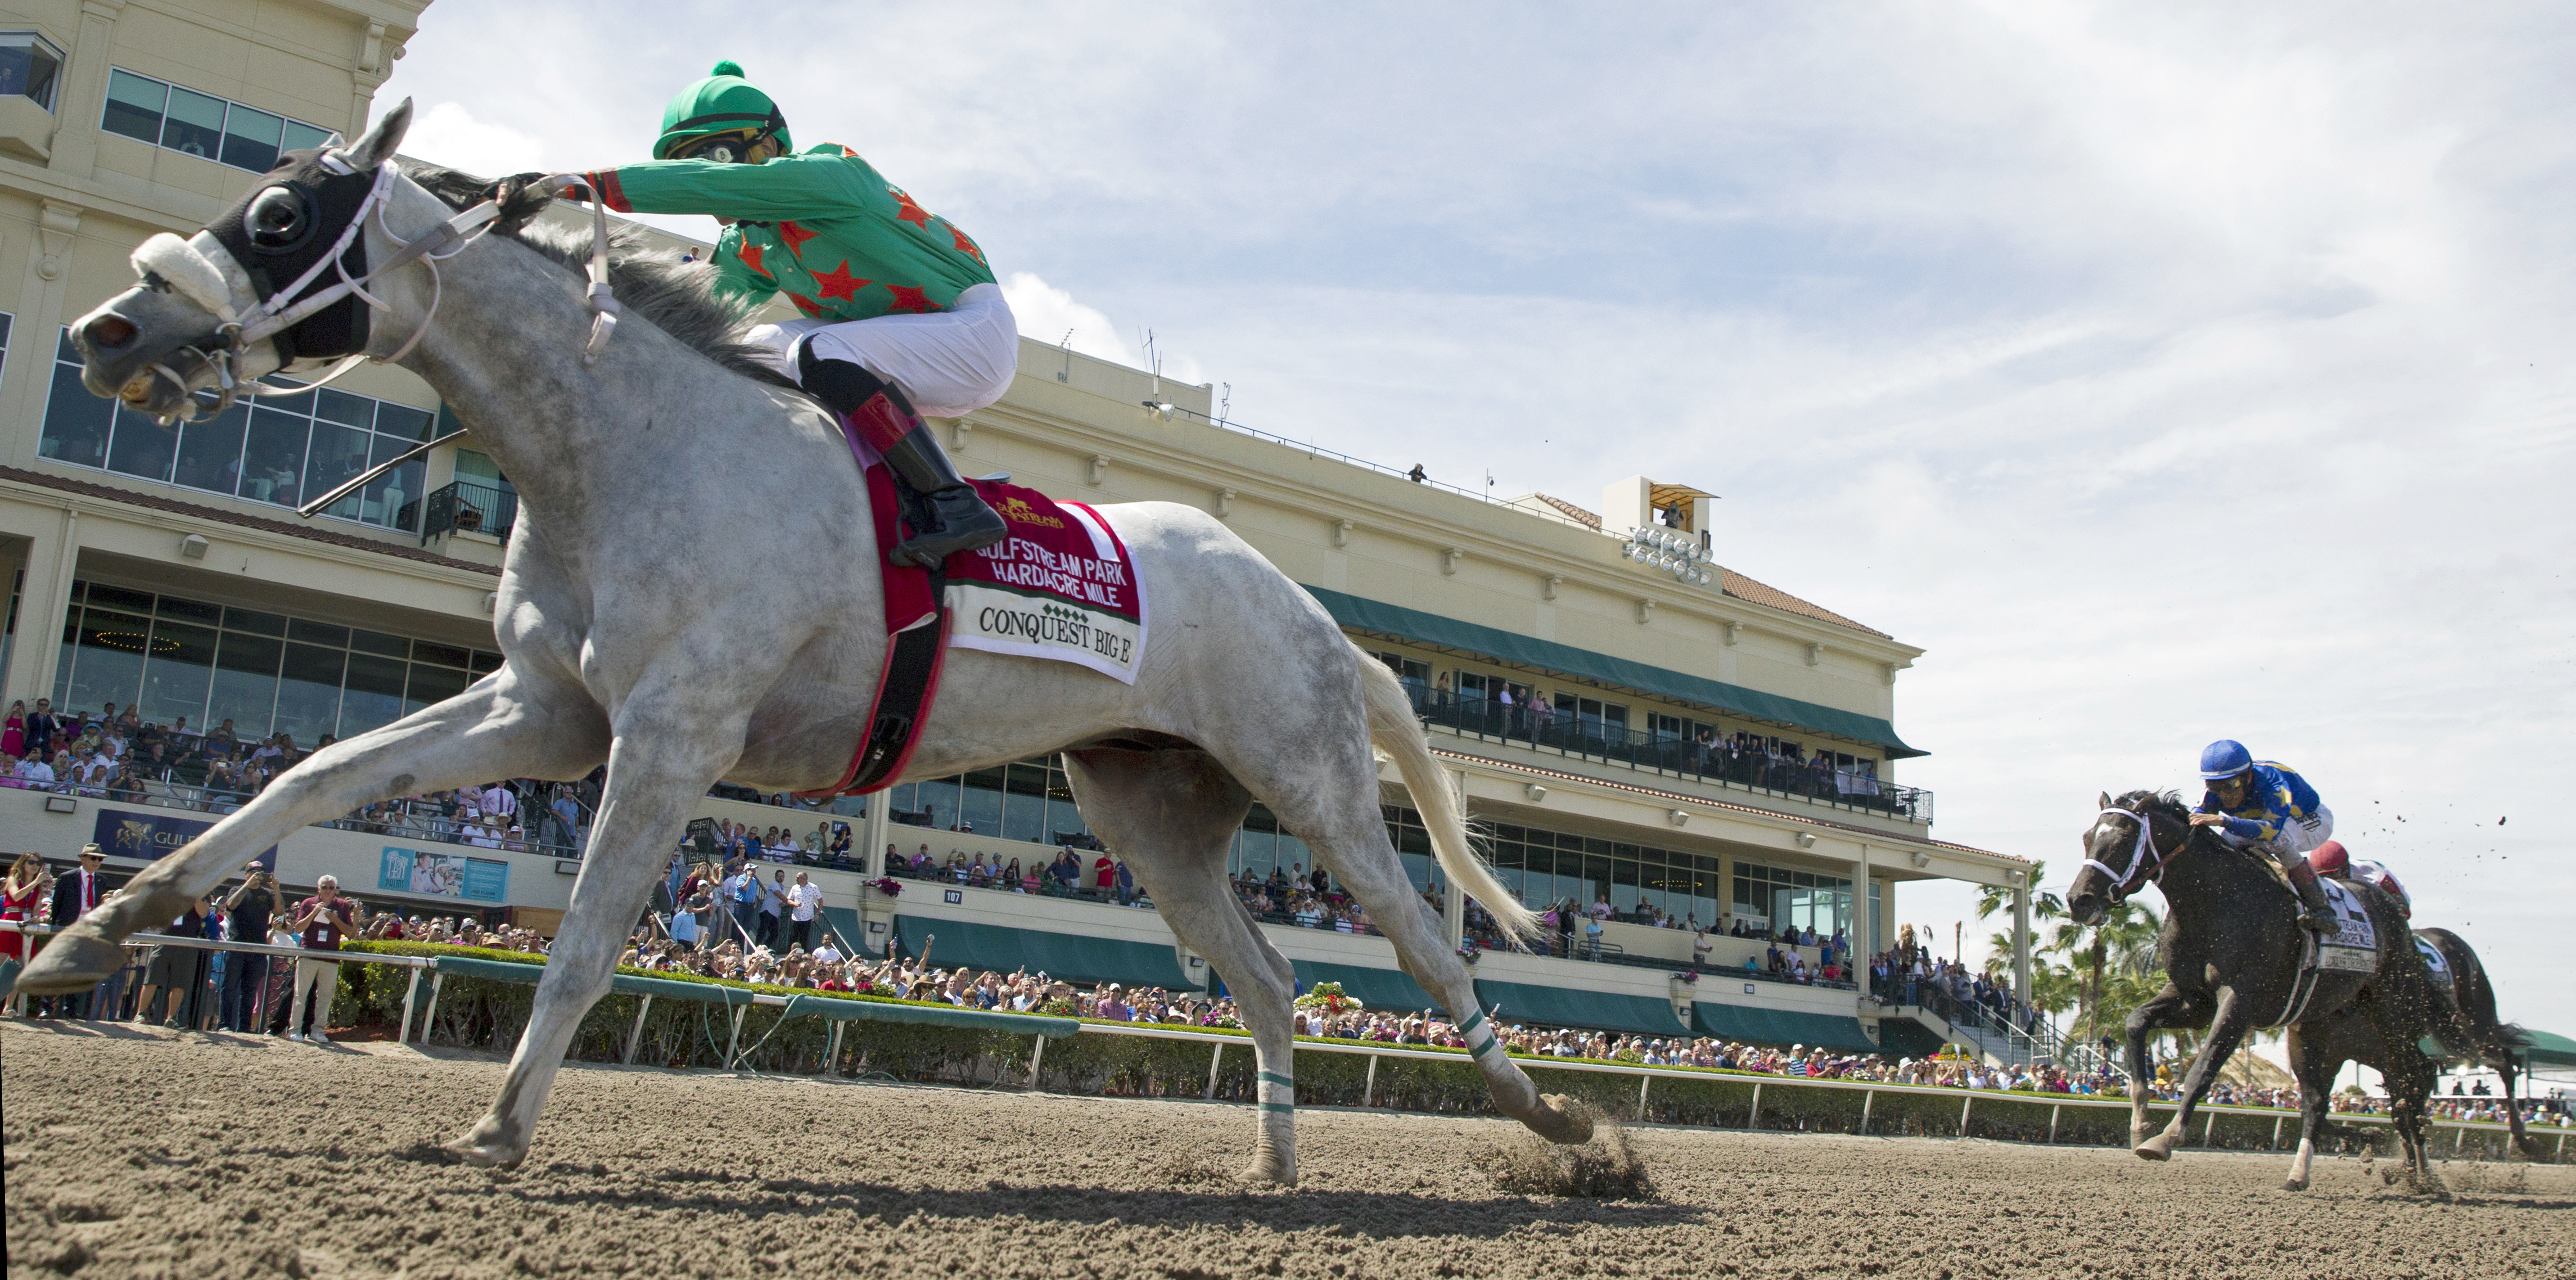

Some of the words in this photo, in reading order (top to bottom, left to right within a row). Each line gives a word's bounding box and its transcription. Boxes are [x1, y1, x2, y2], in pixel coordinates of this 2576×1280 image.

[991, 562, 1084, 600] HARDACRE
[1083, 582, 1122, 607] MILE
[1083, 558, 1127, 586] PARK
[980, 607, 1090, 648] CONQUEST
[1094, 628, 1118, 658] BIG
[1120, 638, 1130, 664] E
[947, 892, 960, 902] 107
